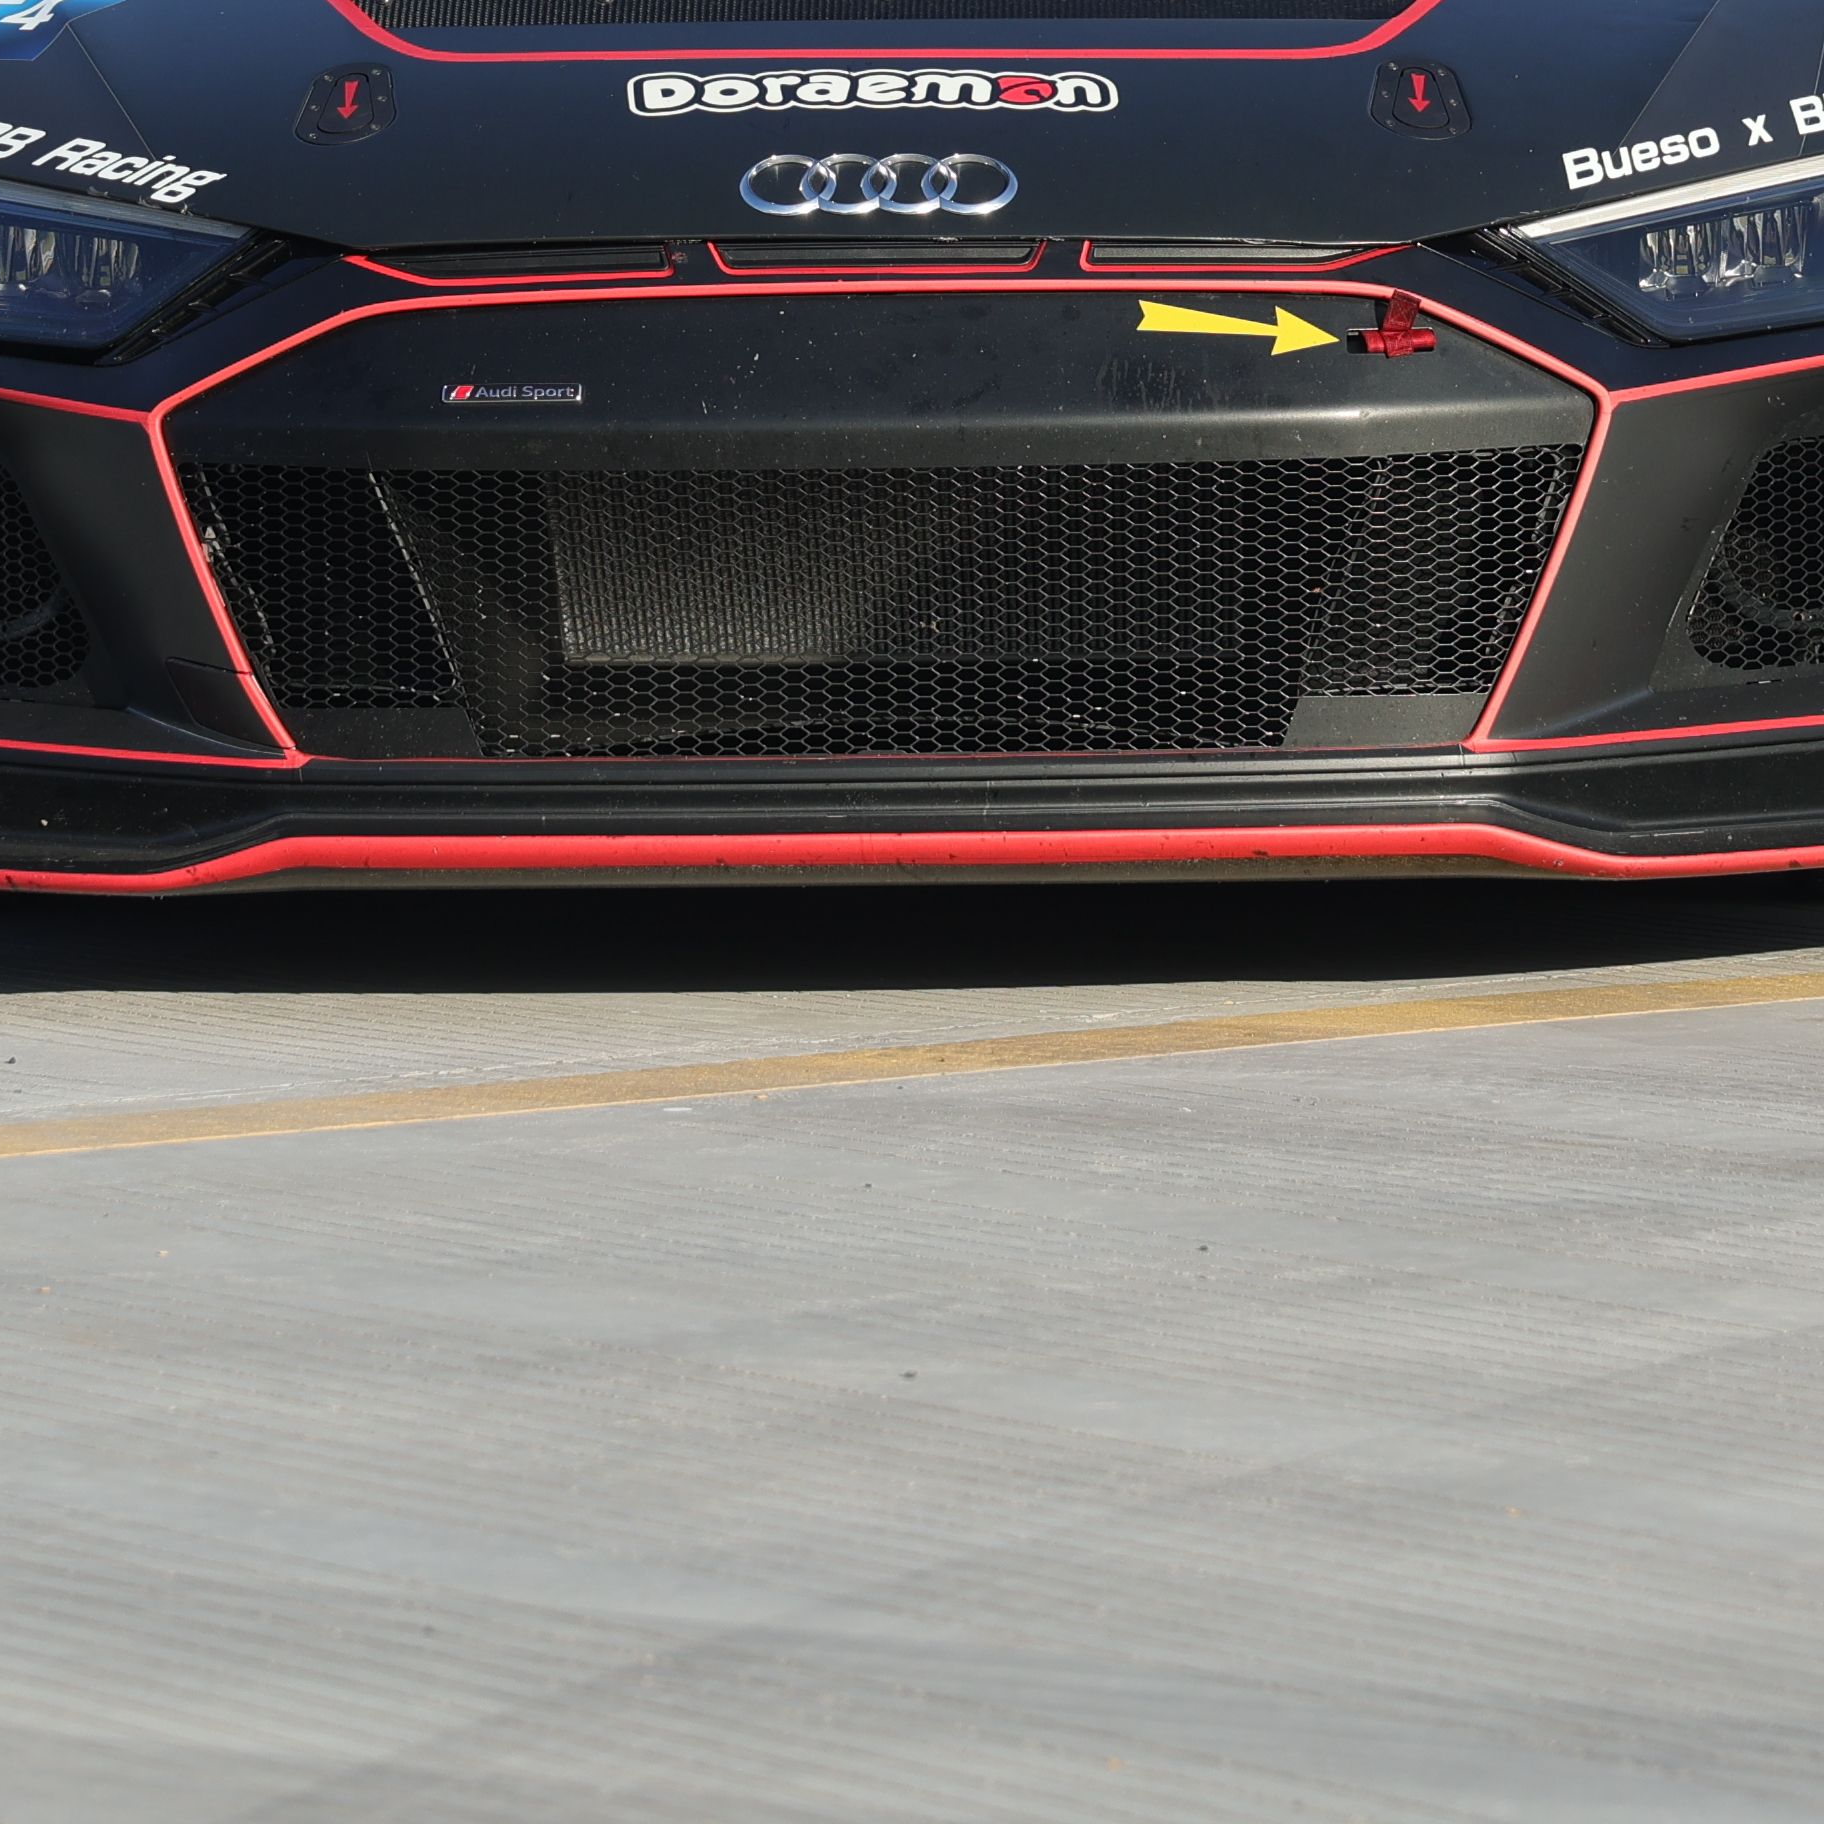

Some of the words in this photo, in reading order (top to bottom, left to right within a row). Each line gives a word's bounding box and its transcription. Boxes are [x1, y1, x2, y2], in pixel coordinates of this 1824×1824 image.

[641, 75, 1102, 111] Doraemon
[31, 136, 228, 204] Racing
[1561, 126, 1721, 191] Bueso
[1741, 113, 1774, 148] x
[475, 385, 518, 398] Audi
[522, 385, 574, 400] Sport
